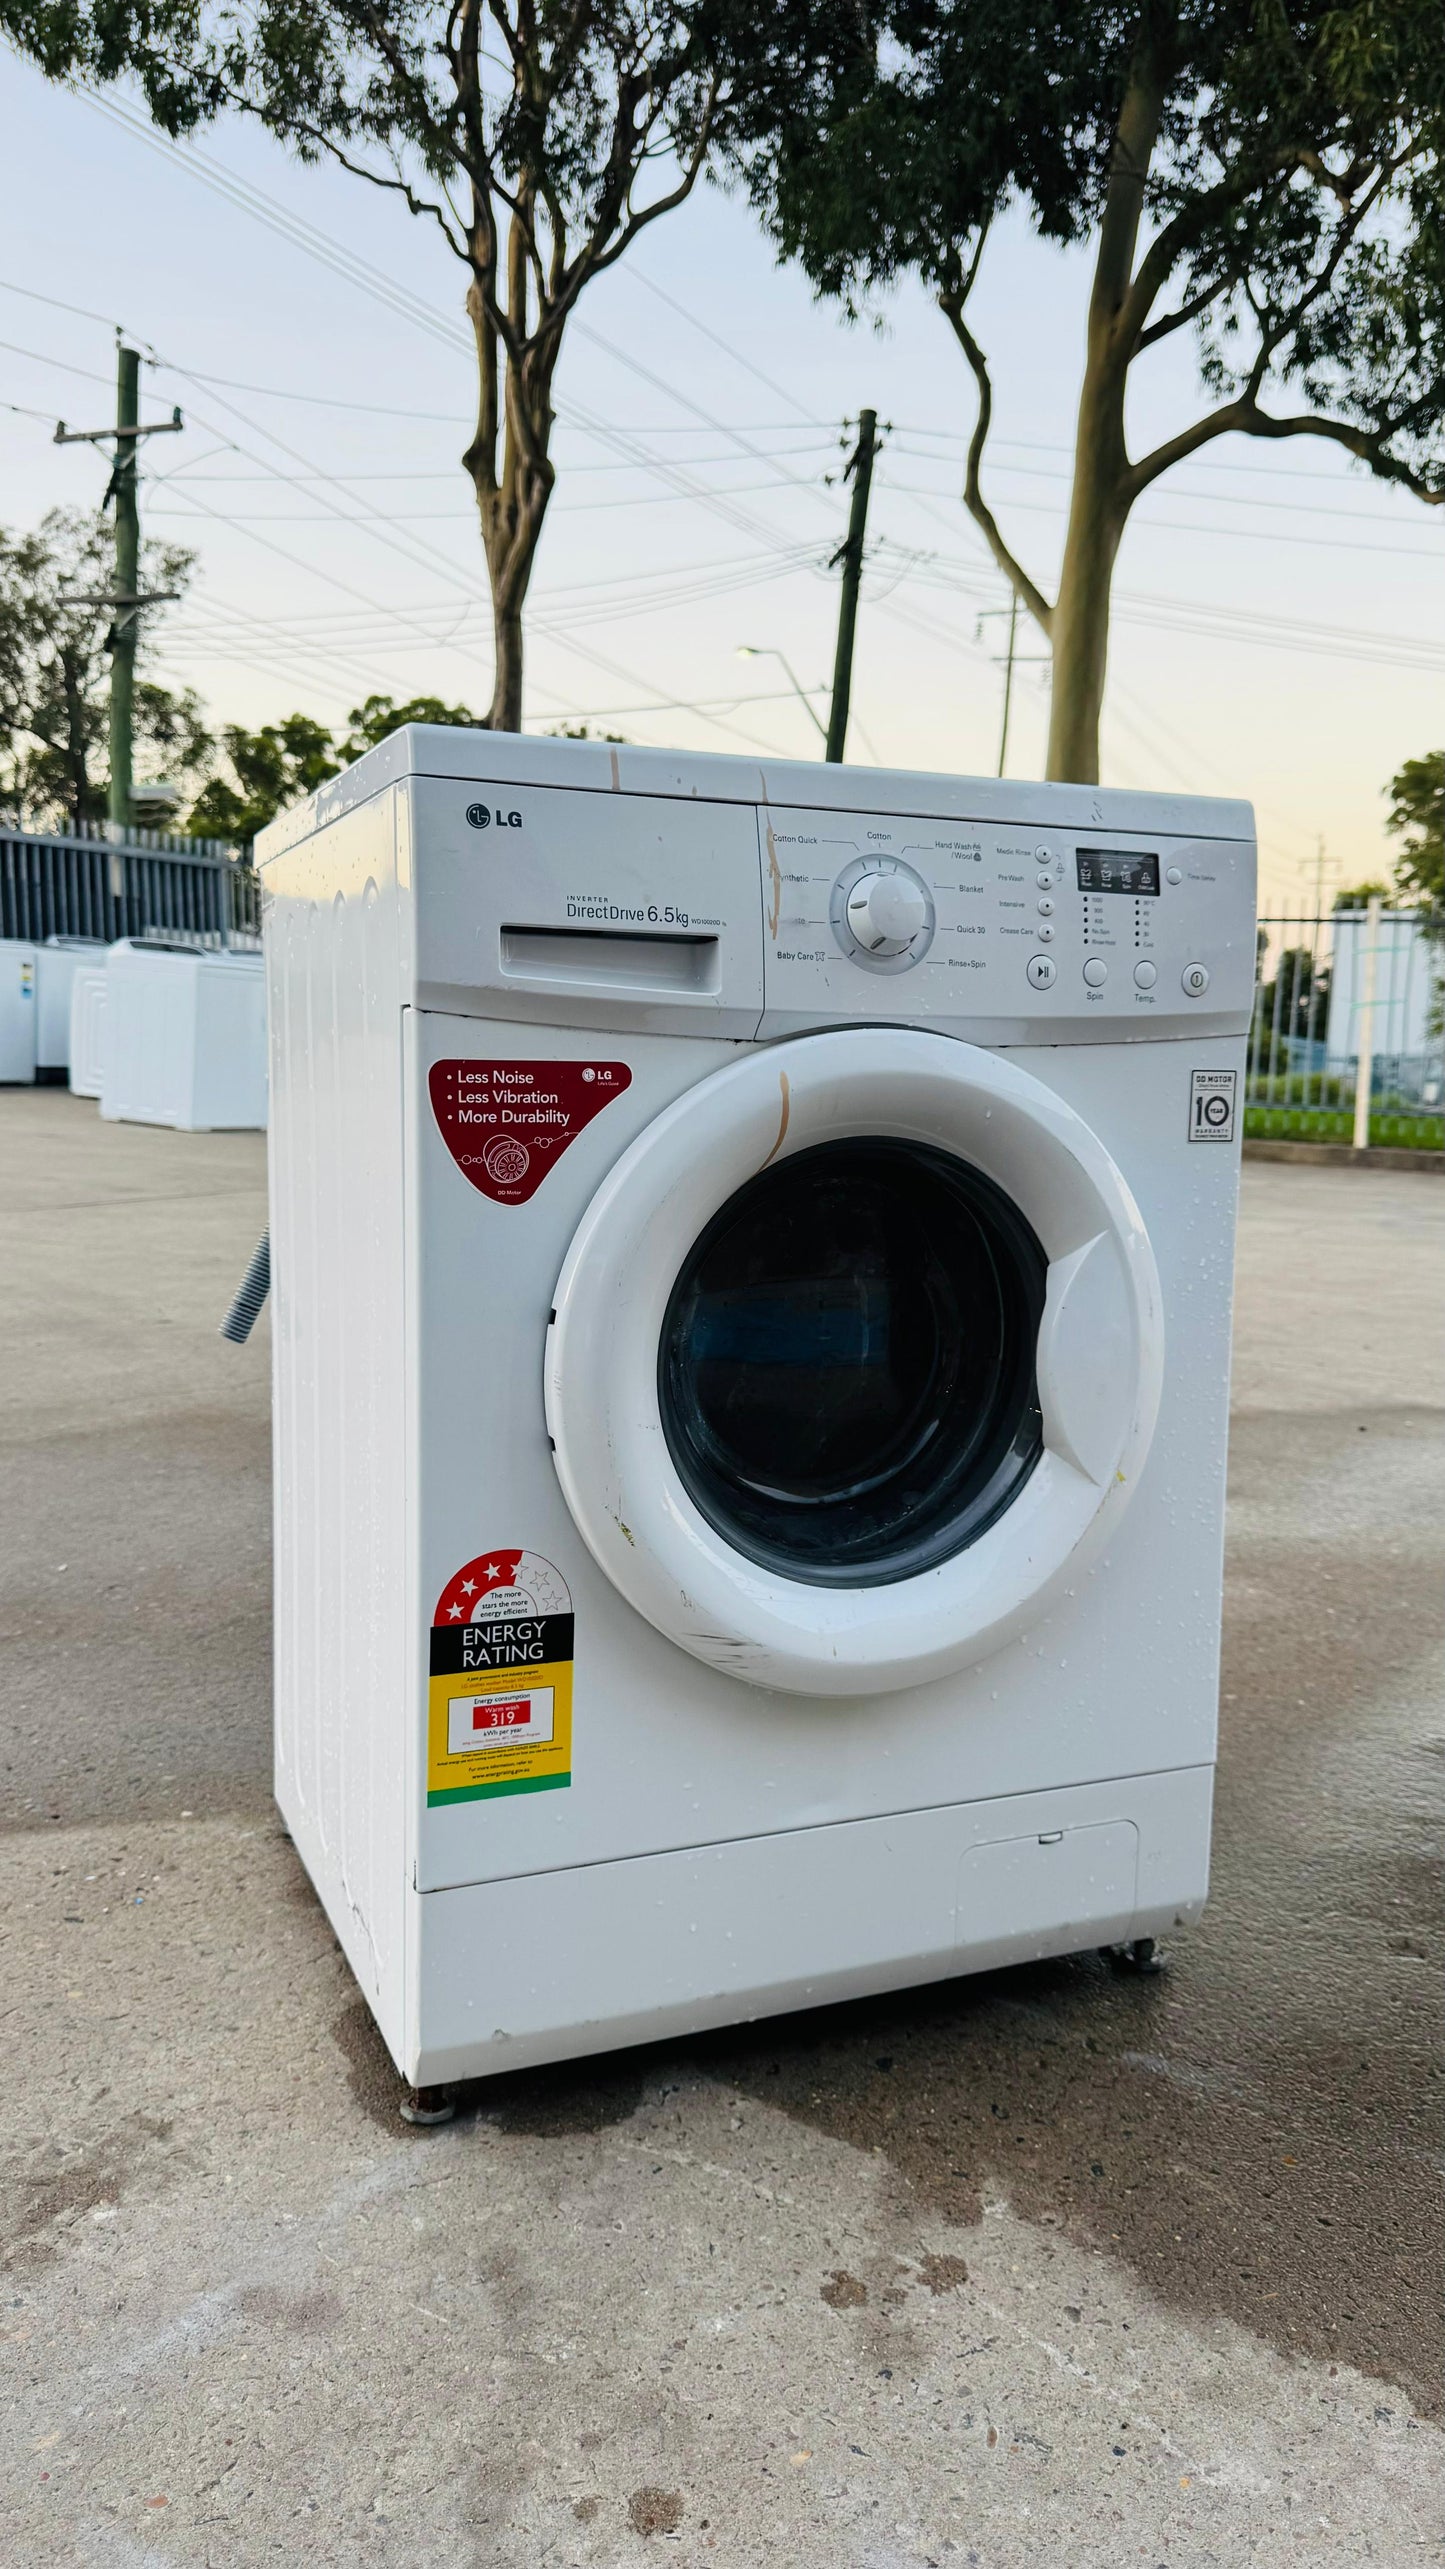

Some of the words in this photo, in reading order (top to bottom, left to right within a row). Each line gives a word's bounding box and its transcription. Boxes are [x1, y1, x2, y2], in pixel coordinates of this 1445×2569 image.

[495, 810, 523, 828] LG
[772, 834, 797, 844] Cotton
[797, 836, 818, 845] Quick
[866, 831, 892, 841] Cotton
[935, 841, 952, 849] Hand
[954, 842, 973, 850] Wash
[959, 885, 984, 894] Blanket
[566, 895, 609, 903] INVERTER
[956, 926, 976, 935] Quick
[977, 926, 986, 934] 30
[777, 951, 796, 962] Baby
[797, 952, 814, 960] Care
[1086, 992, 1104, 1001] Spin
[1134, 994, 1156, 1003] Temp.
[457, 1070, 489, 1084] Less
[493, 1070, 534, 1084] Noise
[598, 1071, 612, 1080] LG
[458, 1090, 489, 1104] Less
[492, 1090, 558, 1104] Vibration
[1196, 1095, 1229, 1126] 10
[458, 1110, 497, 1123] More
[501, 1109, 570, 1126] Durability
[463, 1621, 546, 1646] ENERGY
[463, 1643, 544, 1668] RATING
[474, 1697, 493, 1705] Energy
[494, 1693, 531, 1703] consumption
[490, 1711, 515, 1727] 319
[510, 1727, 523, 1735] year
